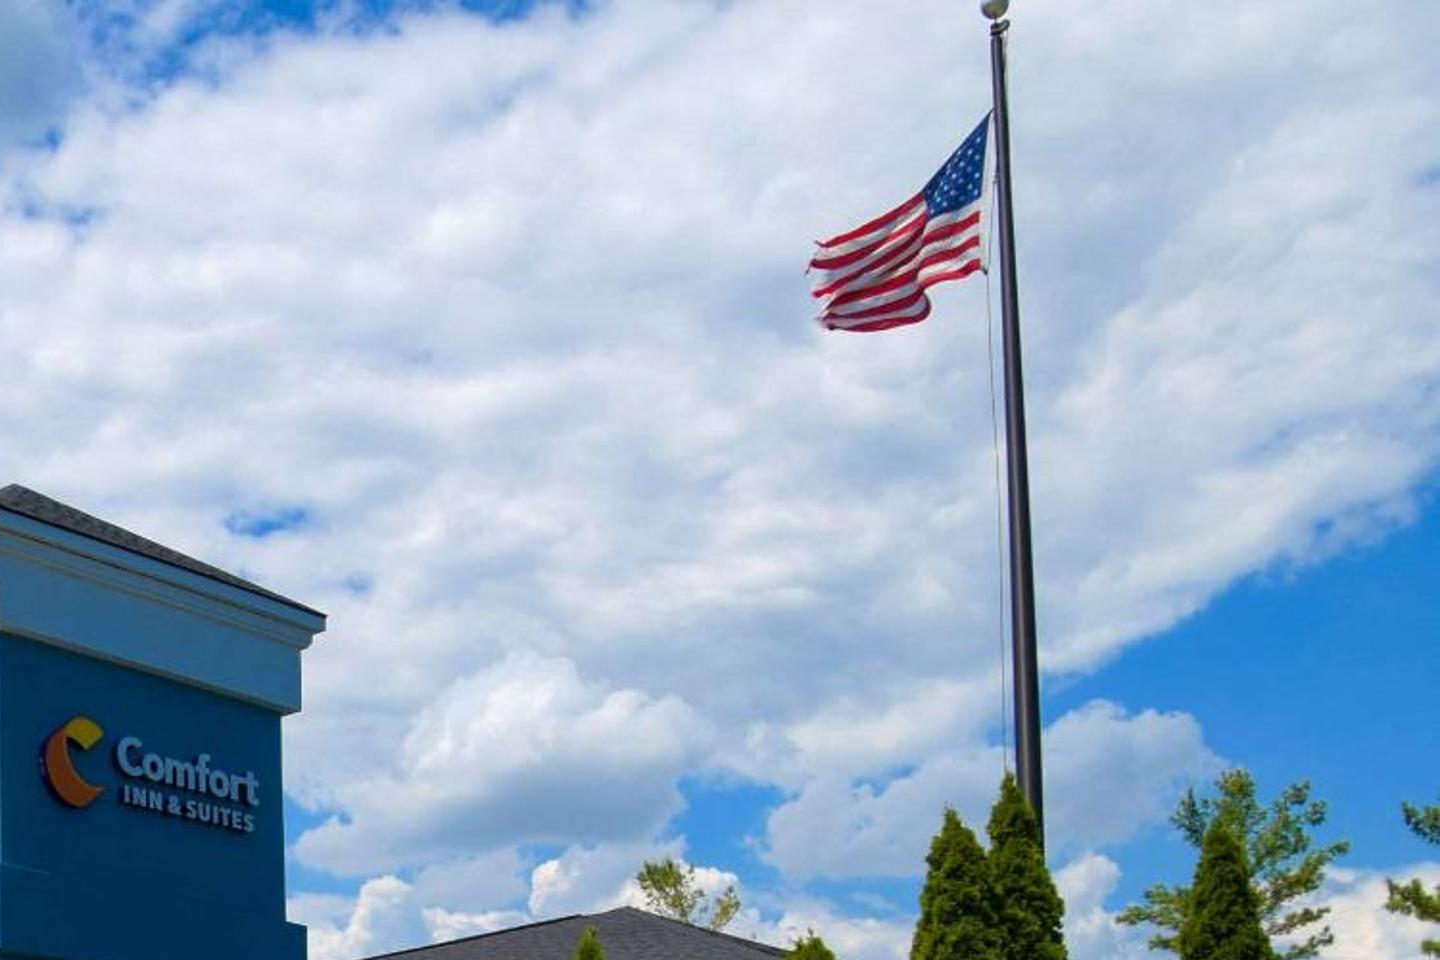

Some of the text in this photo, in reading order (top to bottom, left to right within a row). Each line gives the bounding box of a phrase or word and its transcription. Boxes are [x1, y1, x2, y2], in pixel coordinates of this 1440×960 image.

[117, 736, 259, 806] Comfort
[122, 784, 256, 832] INN & SUITES
